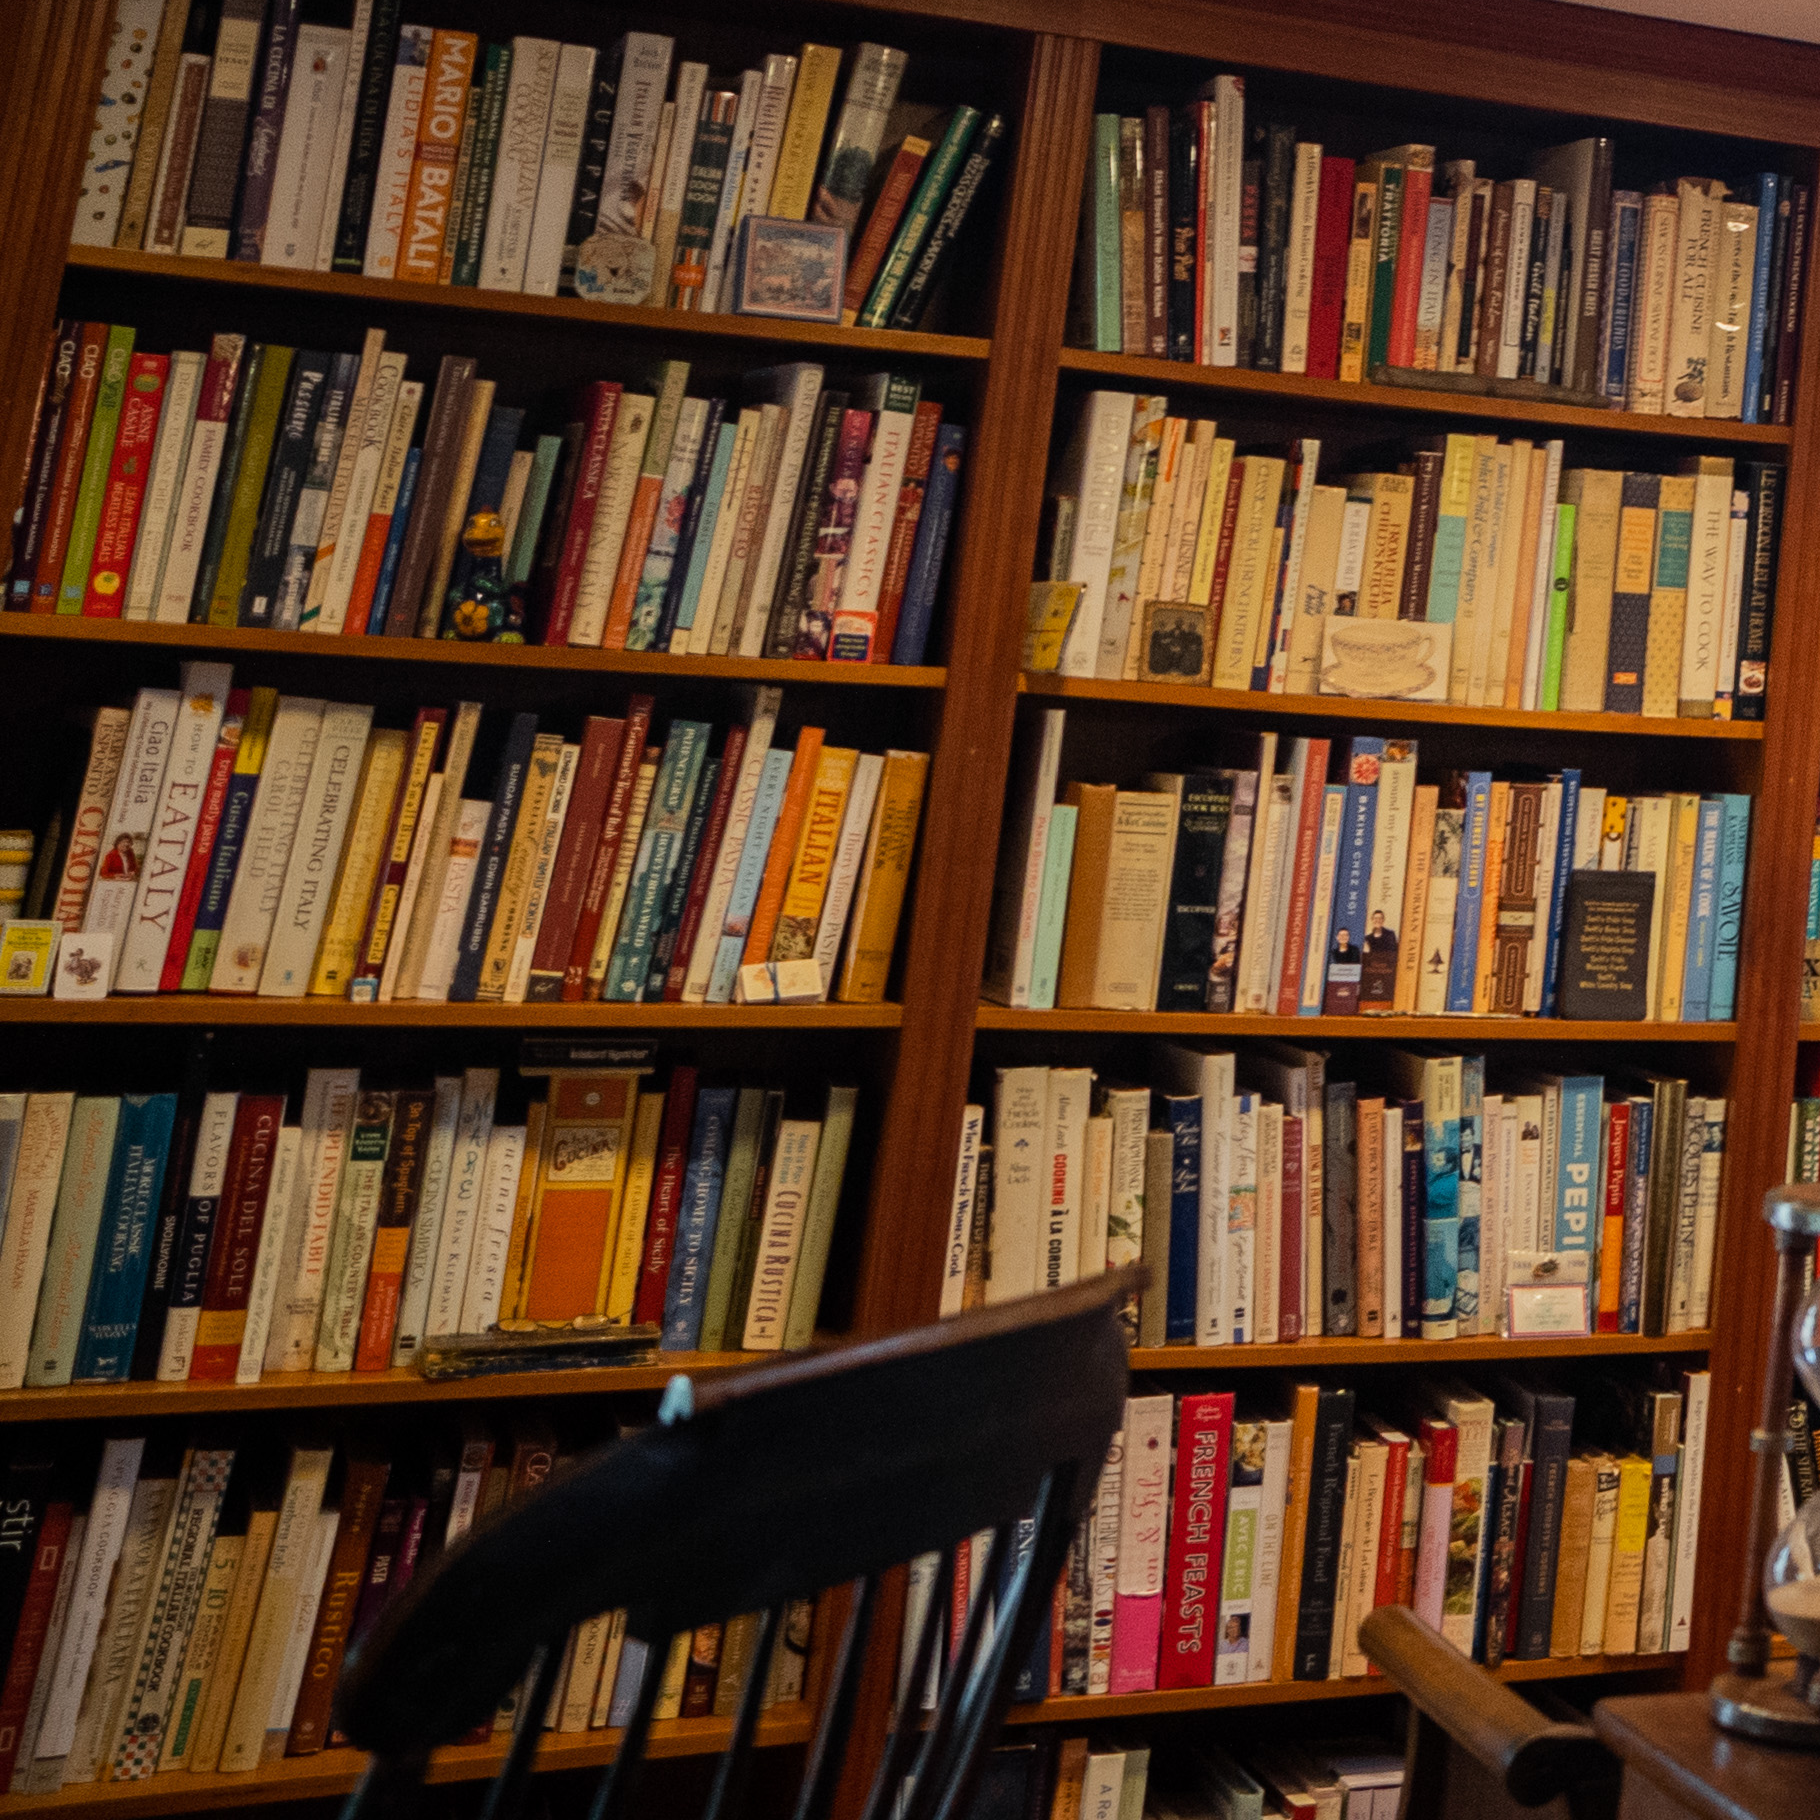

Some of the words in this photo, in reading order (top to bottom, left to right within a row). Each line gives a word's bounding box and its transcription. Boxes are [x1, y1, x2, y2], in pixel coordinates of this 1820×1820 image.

[430, 38, 468, 138] MARIO
[631, 81, 651, 127] ITALIAN
[398, 75, 427, 158] LIDIA'S
[579, 81, 614, 218] ZUPPA!
[385, 171, 413, 235] ITALY
[407, 167, 449, 267] BATALI
[1242, 184, 1257, 239] PASTA
[1377, 182, 1396, 263] TRATTORIA
[1683, 238, 1698, 264] FOR
[1695, 208, 1713, 269] FRENCH
[1680, 267, 1695, 304] ALL
[1690, 273, 1708, 335] CUISINE
[120, 397, 141, 448] CASALE
[135, 403, 155, 442] ANNE
[598, 392, 618, 428] PASTA
[194, 428, 217, 472] FAMILY
[582, 431, 611, 500] CLASSICA
[873, 431, 900, 506] ITALIAN
[180, 475, 207, 552] COOKBOOK
[589, 439, 626, 548] NORTHERN
[734, 484, 763, 559] RISOTTO
[1373, 501, 1391, 557] CHILD'S
[1386, 523, 1402, 563] FROM
[1705, 507, 1721, 540] THE
[856, 511, 885, 597] CLASSICS
[1701, 546, 1718, 586] WAY
[576, 557, 603, 608] ITALY
[1381, 564, 1397, 605] JULIA
[1700, 592, 1714, 616] TO
[1695, 620, 1711, 672] COOK
[146, 720, 169, 756] Ciao
[190, 723, 204, 754] HOW
[134, 761, 163, 805] Italia
[184, 759, 197, 776] TO
[503, 763, 521, 806] SUNDAY
[767, 756, 784, 798] EVERY
[1389, 769, 1404, 810] around
[224, 791, 250, 840] Gusto
[306, 745, 349, 872] CELEBRATING
[494, 808, 512, 841] PASTA
[755, 804, 775, 846] NIGHT
[1353, 795, 1367, 846] BAKING
[1384, 812, 1398, 832] my
[139, 780, 199, 933] EATALY
[797, 789, 842, 886] ITALIAN
[1384, 835, 1398, 871] french
[207, 845, 238, 912] Italiano
[483, 856, 499, 890] EDWIN
[737, 852, 761, 912] ITALIAN
[1349, 851, 1363, 886] CHEZ
[1380, 874, 1395, 904] table
[293, 879, 318, 931] ITALY
[469, 893, 493, 951] GARRUBBO
[1347, 891, 1358, 916] MOI
[246, 1114, 273, 1193] CUCINA
[698, 1115, 720, 1178] COMING
[1610, 1116, 1627, 1167] Jacques
[362, 1168, 376, 1191] THE
[691, 1182, 711, 1227] HOME
[1051, 1154, 1067, 1205] COOKING
[237, 1200, 258, 1240] DEL
[355, 1193, 374, 1242] ITALIAN
[687, 1231, 704, 1253] TO
[226, 1246, 250, 1298] SOLE
[346, 1244, 366, 1301] COUNTRY
[677, 1257, 699, 1307] SICILY
[1046, 1239, 1061, 1287] CORDON
[339, 1304, 355, 1339] TABLE
[1186, 1429, 1218, 1543] FRENCH
[179, 1508, 205, 1567] REGIONAL
[165, 1567, 190, 1621] ITALIAN
[1177, 1551, 1208, 1652] FEASTS
[311, 1570, 360, 1679] Rustico
[149, 1624, 174, 1692] COOKBOOK
